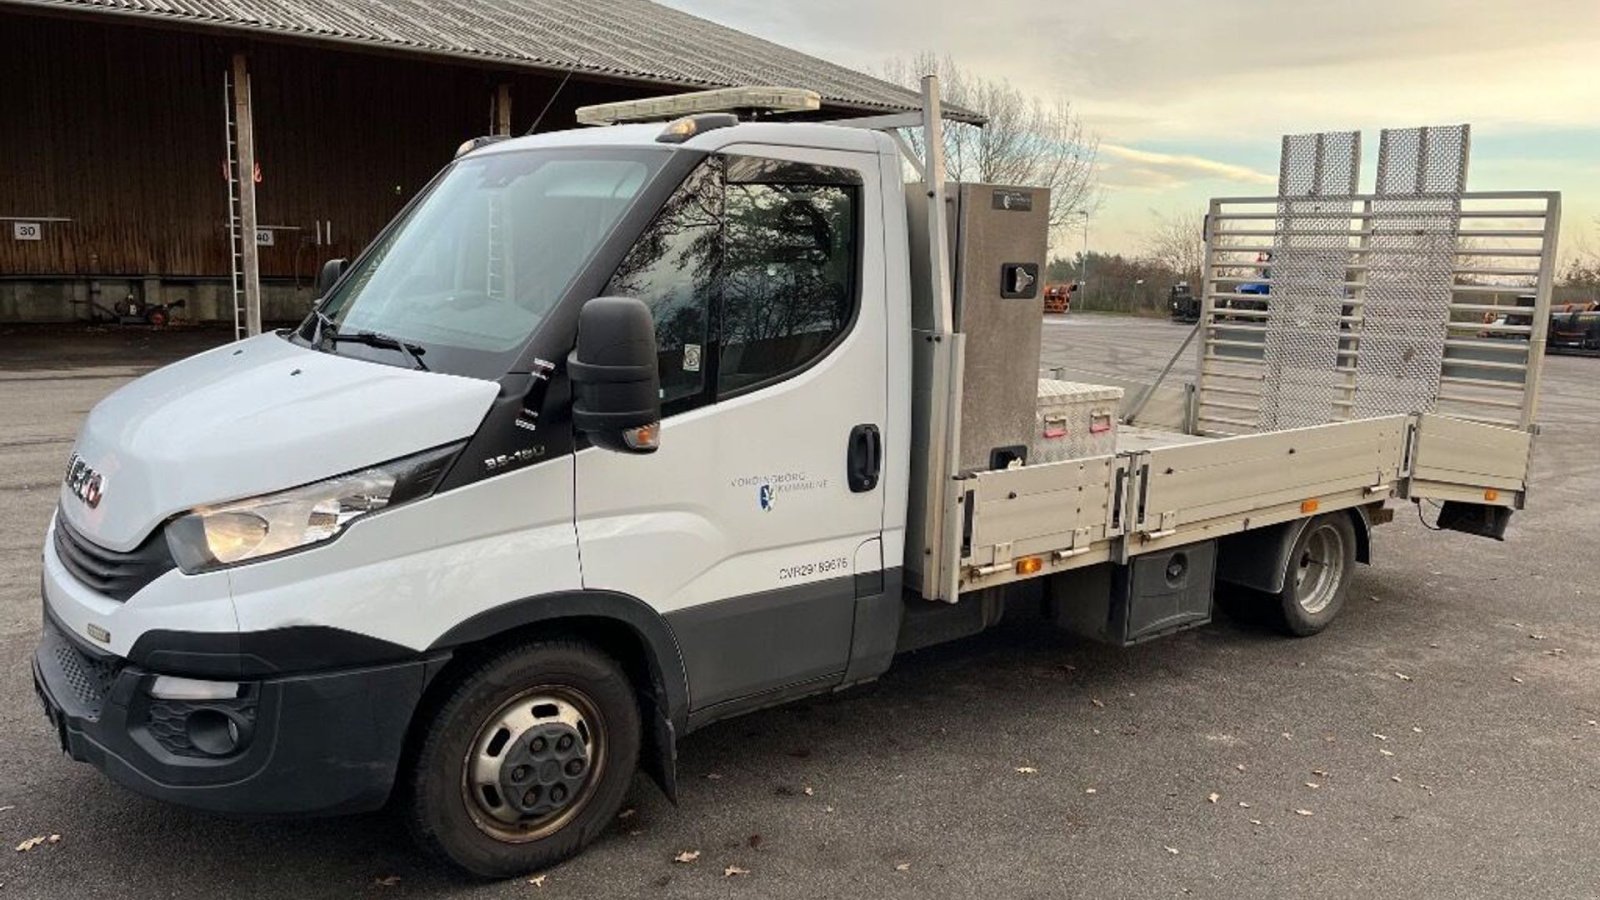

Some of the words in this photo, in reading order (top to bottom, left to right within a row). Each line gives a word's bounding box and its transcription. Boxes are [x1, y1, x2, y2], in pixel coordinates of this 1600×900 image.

[19, 226, 36, 237] 30
[256, 232, 270, 242] 40
[731, 472, 806, 487] VORDINGBORG
